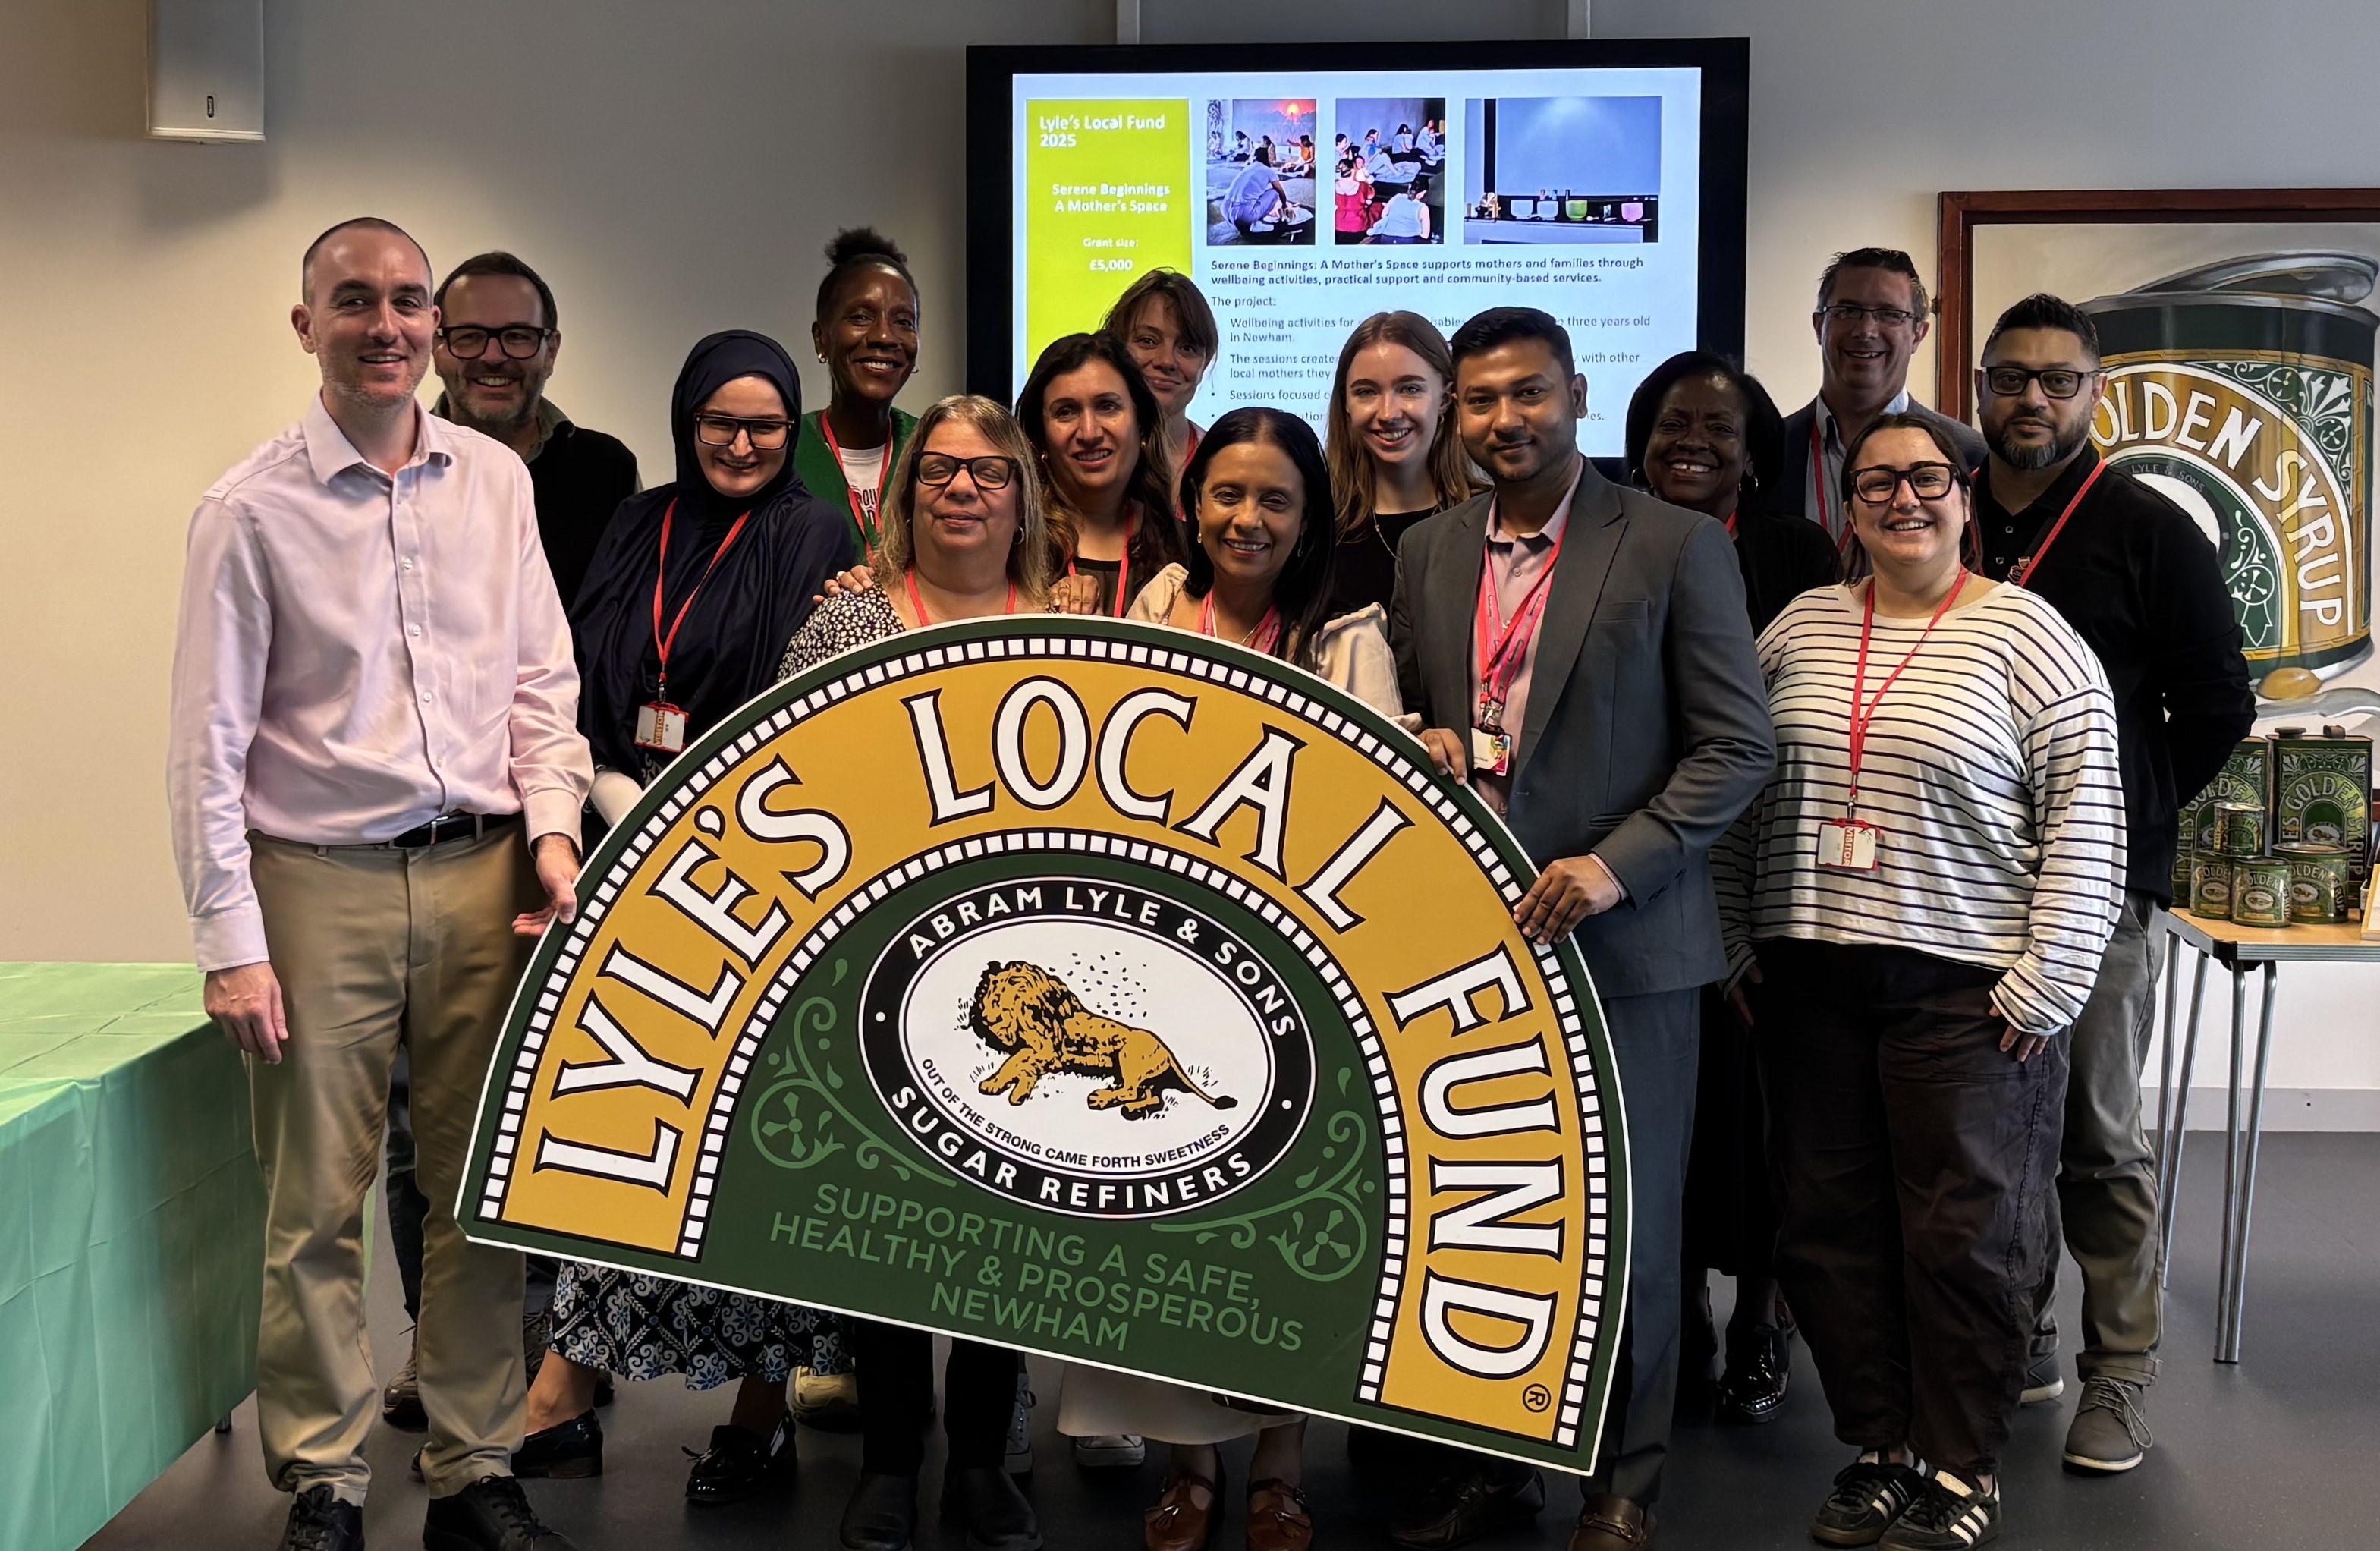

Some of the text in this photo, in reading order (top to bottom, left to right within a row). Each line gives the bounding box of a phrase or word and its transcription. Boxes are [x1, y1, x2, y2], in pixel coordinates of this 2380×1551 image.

[1039, 115, 1165, 133] Lyle's Local Fund
[1040, 134, 1077, 148] 2025
[1052, 183, 1170, 197] Serene Beginnings
[1055, 200, 1167, 213] A Mother's Space
[1083, 238, 1138, 247] Grant size:
[1089, 259, 1133, 271] £5,000
[1212, 258, 1643, 272] Serene Beginnings: A Mother's Space supports mothers and families through
[1212, 273, 1602, 286] wellbeing activities, practical support and community-based services.
[1212, 297, 1276, 309] The project:
[1230, 317, 1284, 329] Wellbeing
[1288, 317, 1336, 328] activities
[1339, 316, 1353, 327] for
[1567, 316, 1597, 326] three
[1601, 317, 1630, 328] years
[1633, 316, 1650, 326] old
[1243, 332, 1294, 343] Newham.
[1230, 354, 1250, 364] The
[1253, 354, 1297, 364] sessions
[1582, 352, 1605, 363] with
[1609, 352, 1640, 363] other
[1230, 368, 1330, 379] local mothers they
[1230, 389, 1275, 400] Sessions
[1278, 389, 1320, 400] focused
[2091, 382, 2343, 627] OLDEN SYRUP
[2285, 777, 2363, 812] GOLDEN
[909, 886, 1295, 1037] ABRAM LYLE & SONS
[533, 753, 854, 1198] LYLE'S
[901, 675, 1415, 934] LOCAL
[1382, 939, 1564, 1380] FUND
[922, 1058, 1231, 1169] OUT OF THE STRONG CAME FORTH SWEETNESS
[892, 1086, 1252, 1210] SUGAR REFINERS
[814, 1182, 1260, 1307] SUPPORTING A SAFE,
[769, 1211, 1305, 1352] HEALTHY & PROSPEROUS
[930, 1282, 1130, 1352] NEWHAM
